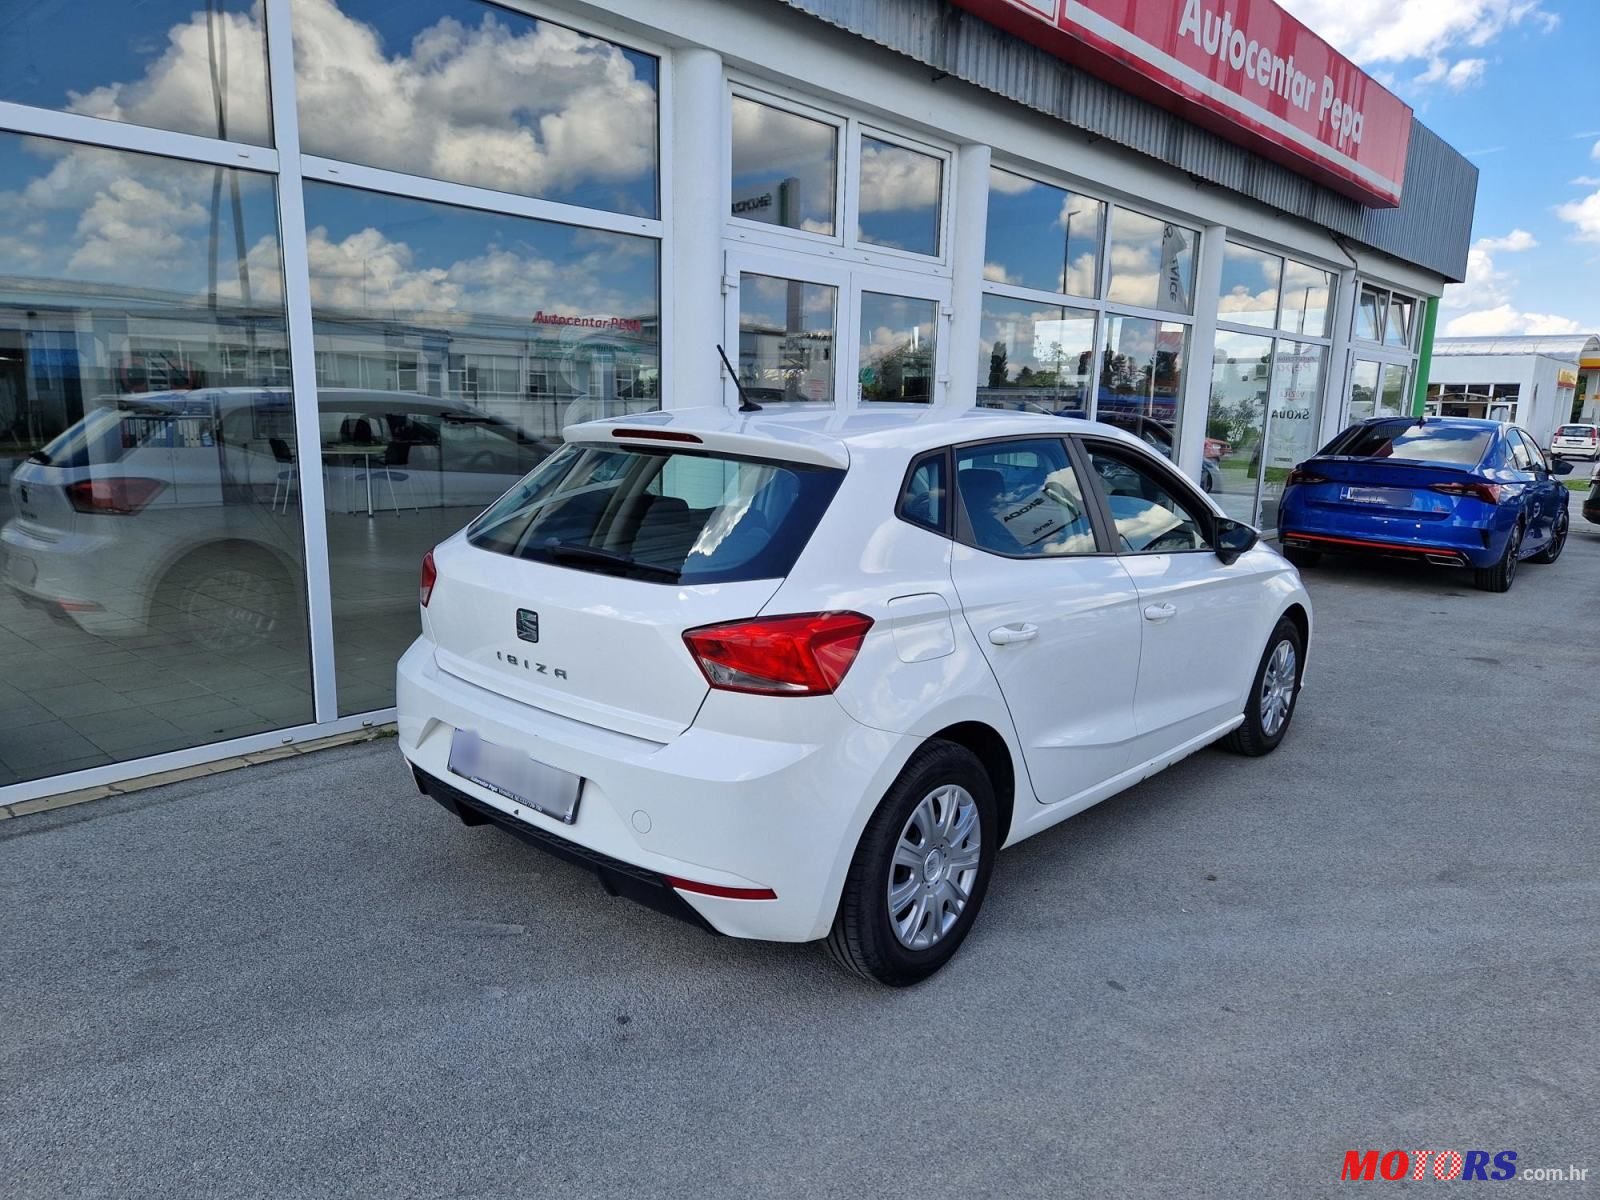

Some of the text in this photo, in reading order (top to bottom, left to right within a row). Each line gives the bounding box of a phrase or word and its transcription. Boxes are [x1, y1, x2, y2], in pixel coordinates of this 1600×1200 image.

[1178, 0, 1363, 148] Autocentar Pepa
[532, 311, 609, 329] Autocentar
[497, 651, 568, 680] IBIZA
